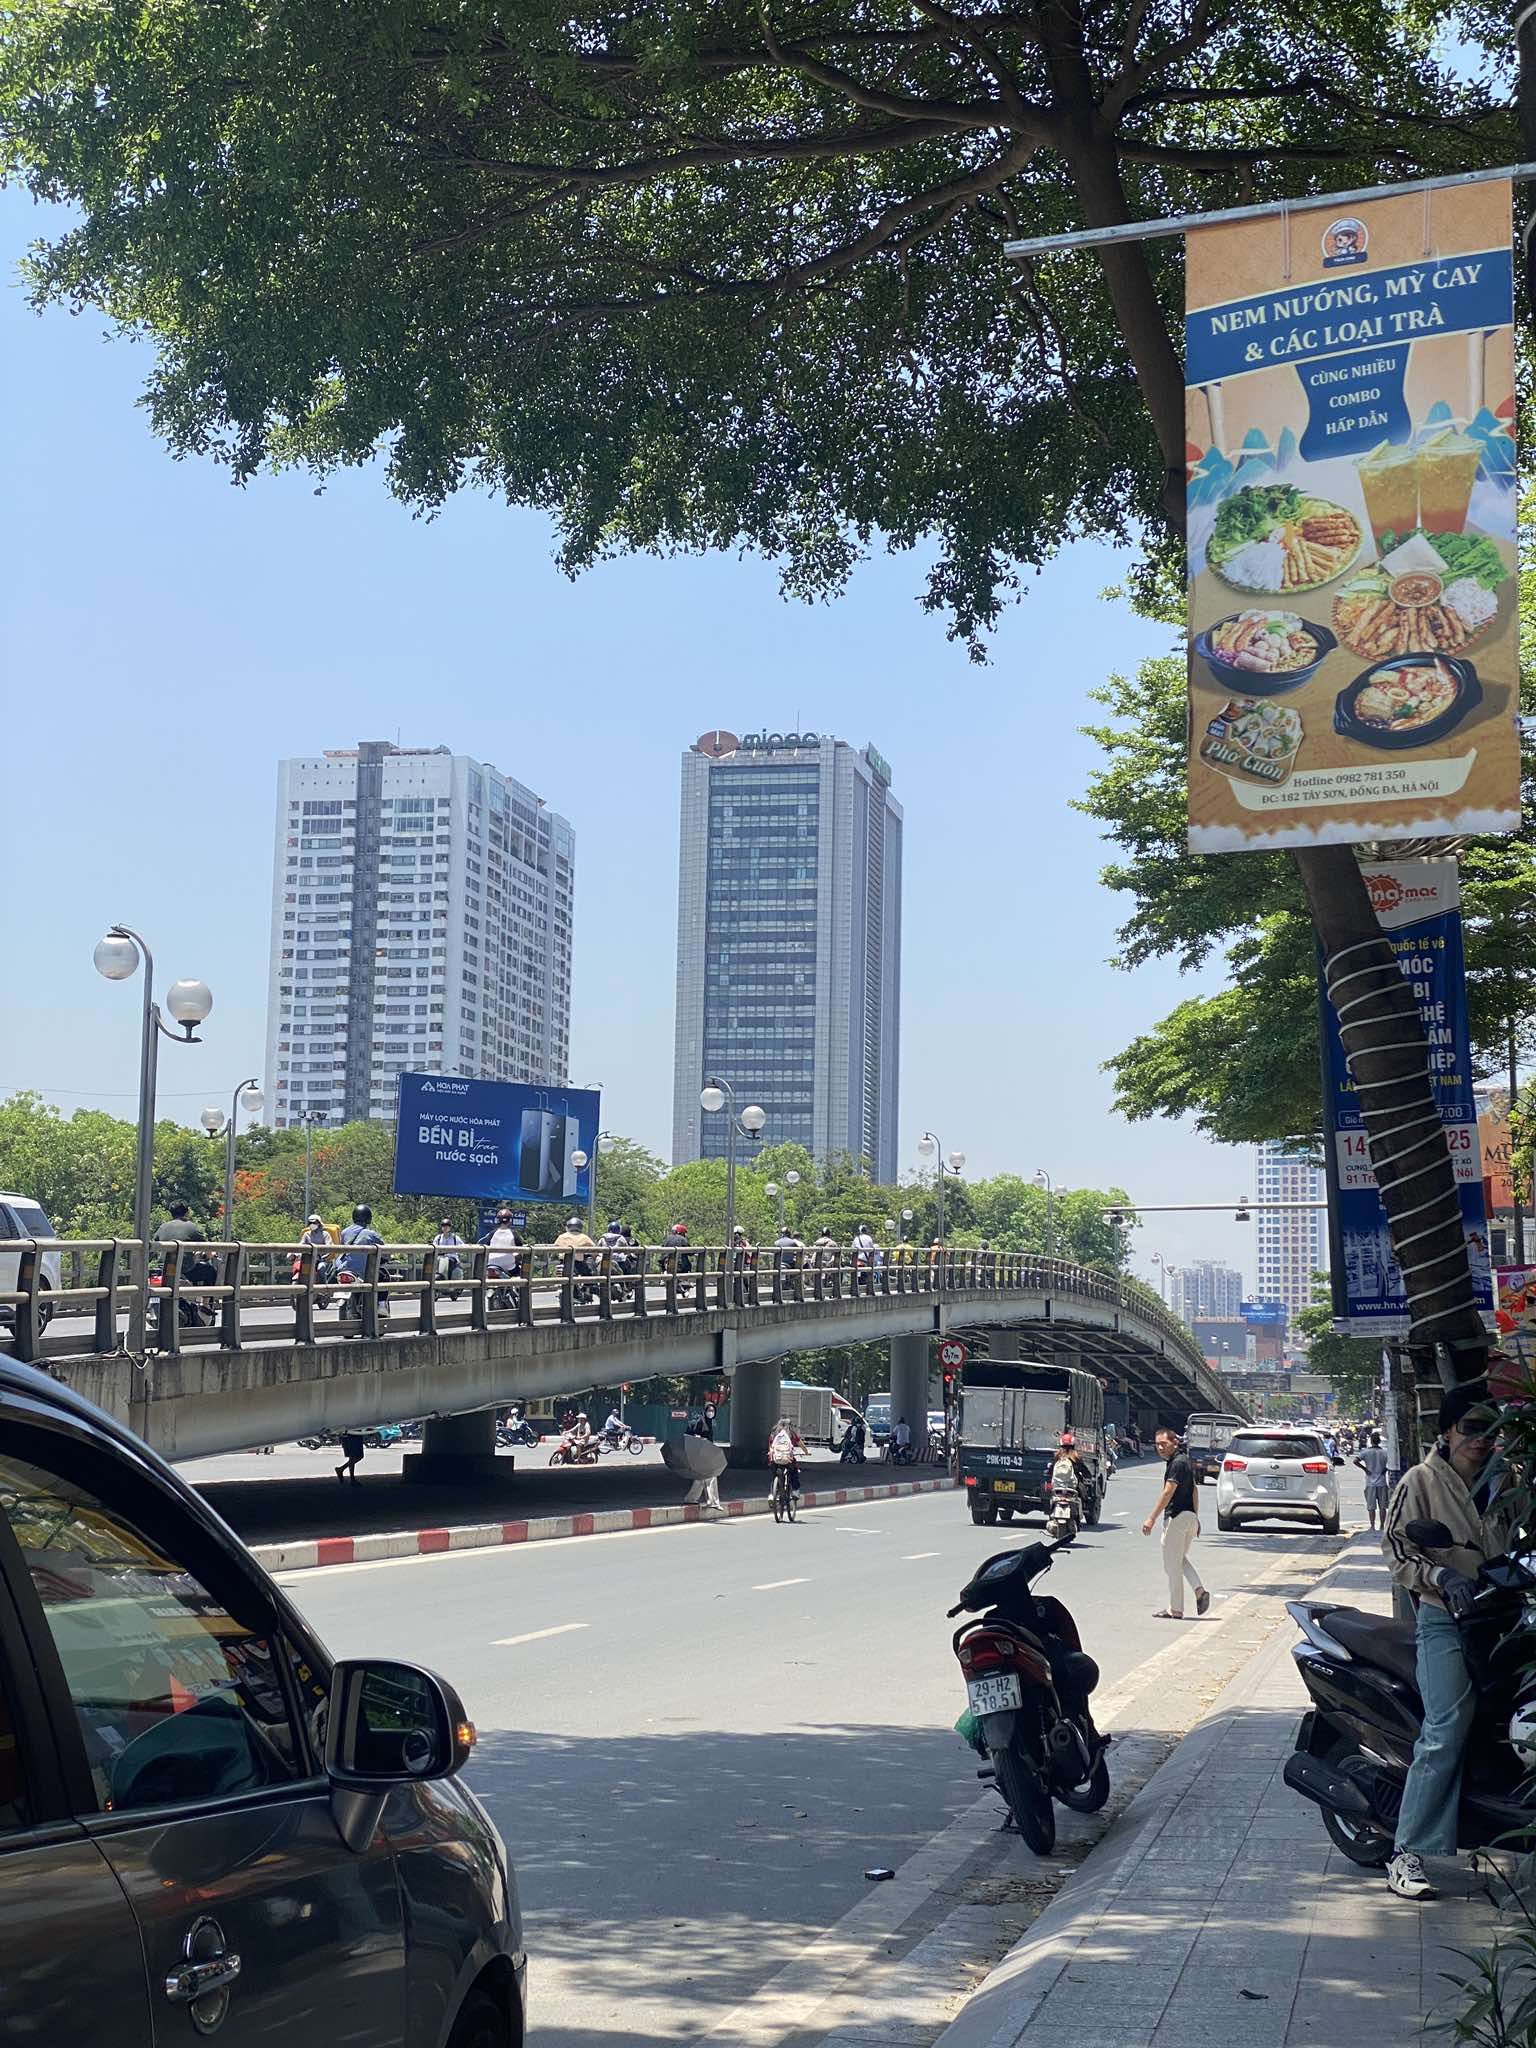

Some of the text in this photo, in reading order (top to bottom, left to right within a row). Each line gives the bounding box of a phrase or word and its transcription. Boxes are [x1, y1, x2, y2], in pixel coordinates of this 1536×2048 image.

[1210, 263, 1483, 335] NEM NƯỚNG, MỲ CAY
[1244, 301, 1445, 362] & CÁC LOẠI TRÀ
[1310, 368, 1349, 386] CÙNG
[1329, 387, 1381, 408] COMBO
[1326, 416, 1356, 435] HẤP
[1293, 775, 1334, 788] Hotline
[1335, 773, 1362, 784] 0982
[1363, 772, 1383, 781] 781
[1413, 981, 1431, 1001] BỊ
[435, 1149, 498, 1166] nước sạch
[1346, 1174, 1358, 1184] 91
[975, 1677, 1011, 1697] 29-H2
